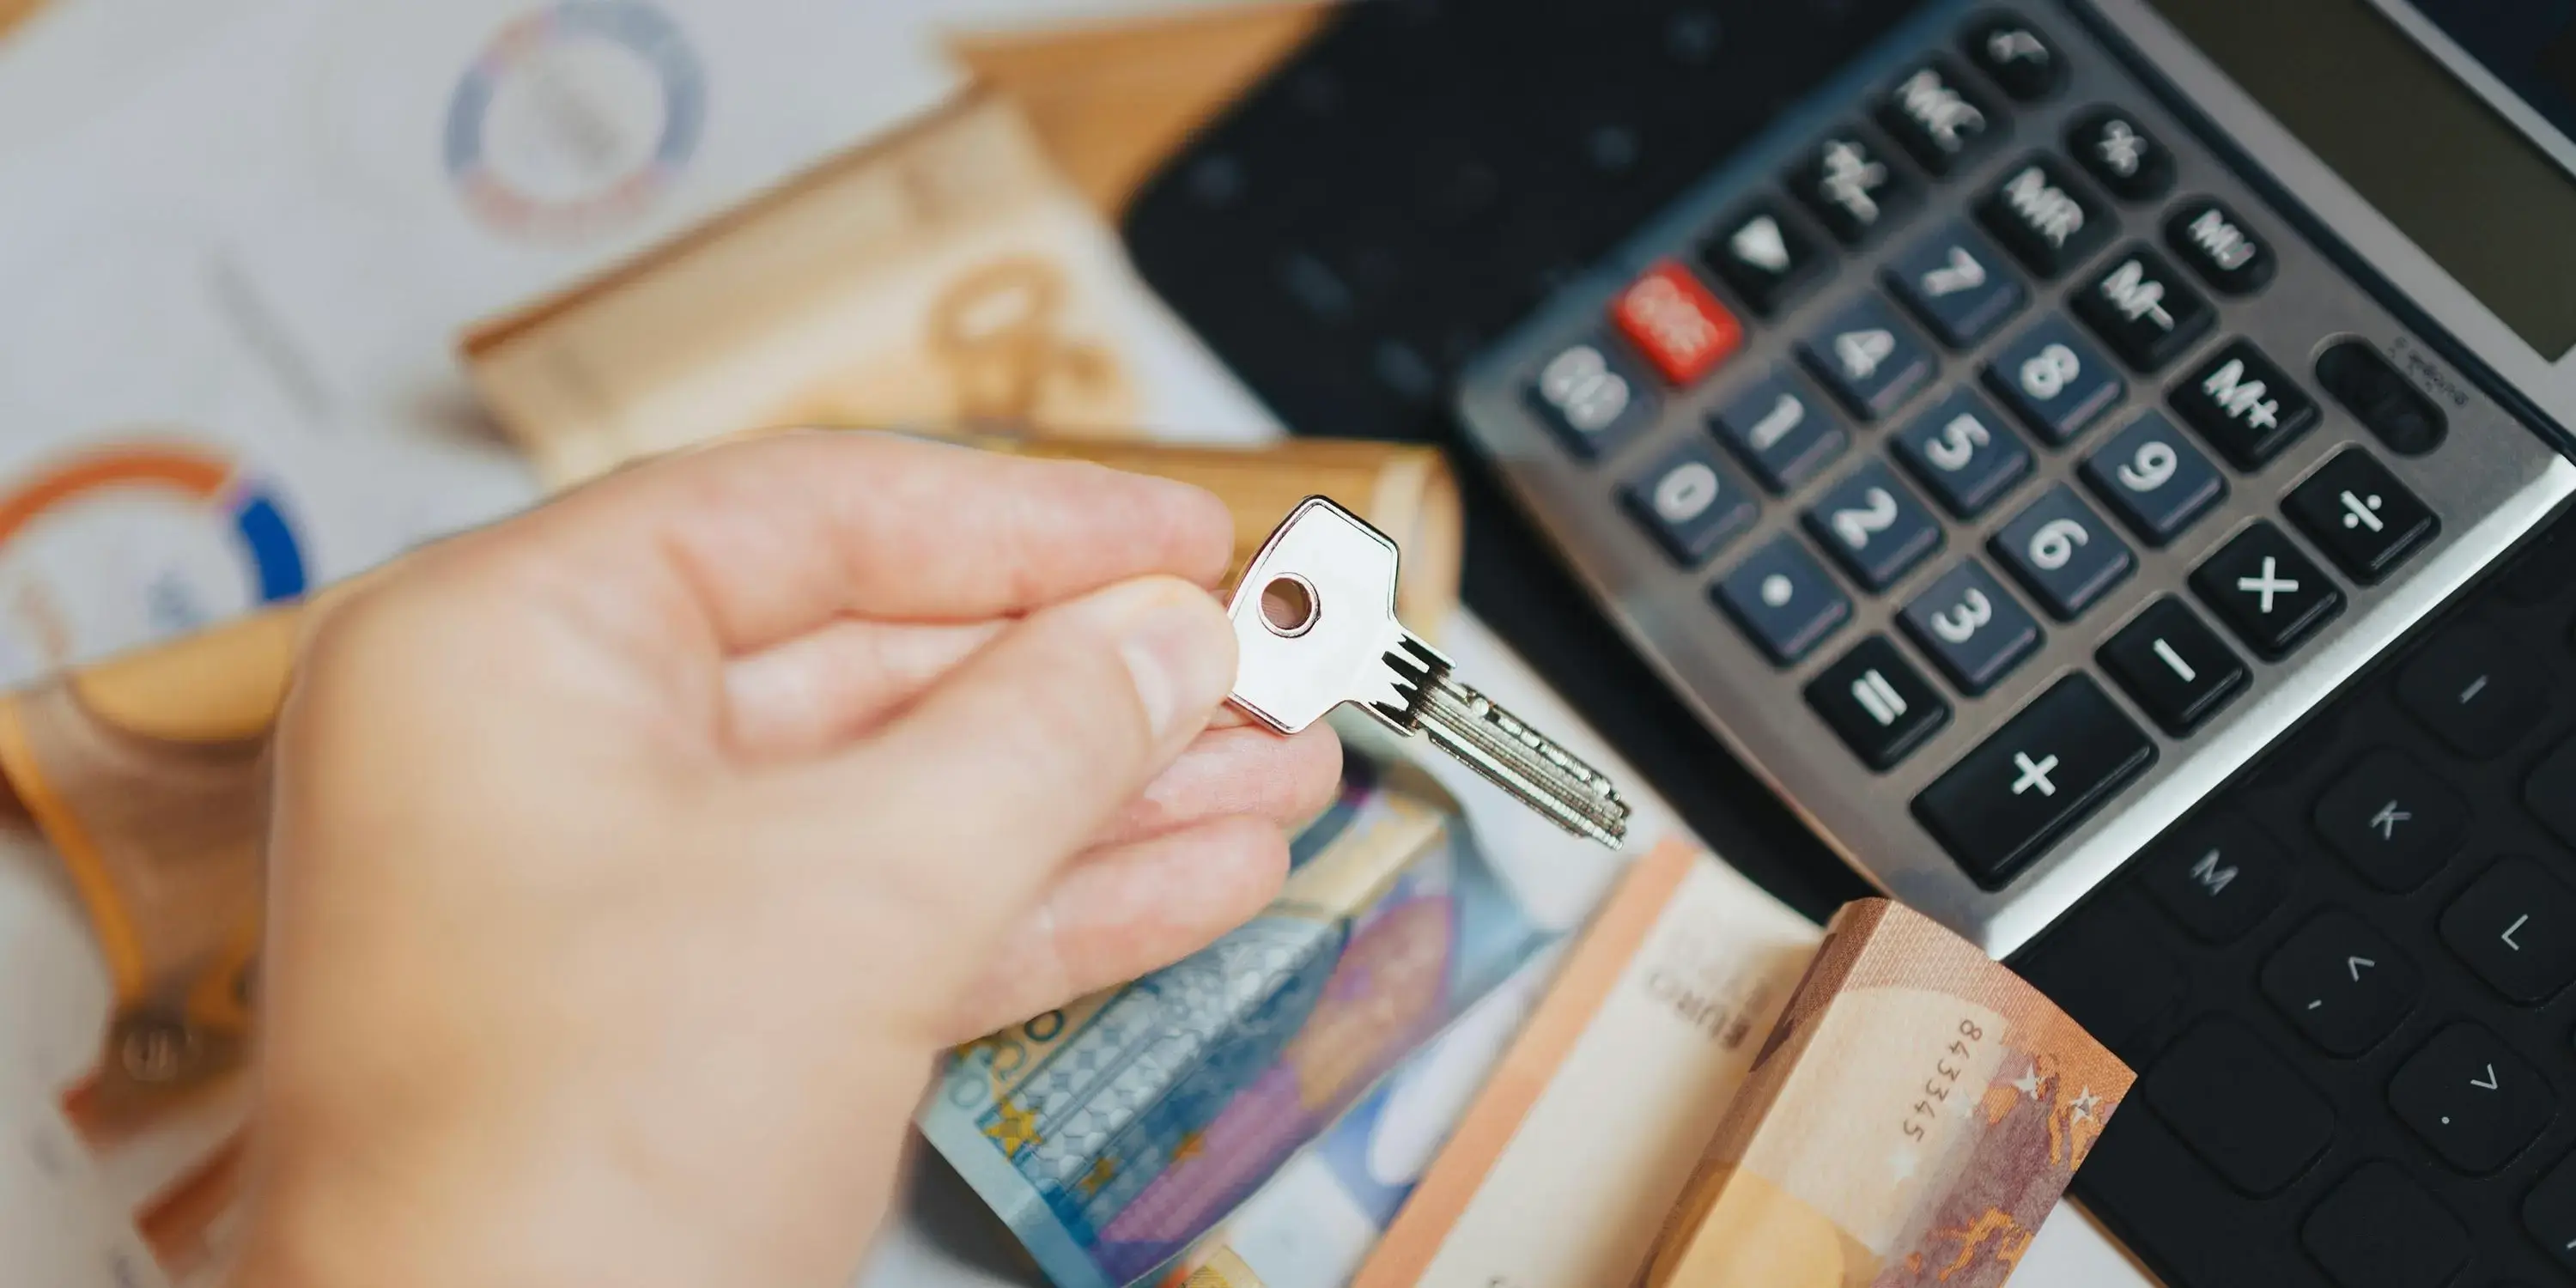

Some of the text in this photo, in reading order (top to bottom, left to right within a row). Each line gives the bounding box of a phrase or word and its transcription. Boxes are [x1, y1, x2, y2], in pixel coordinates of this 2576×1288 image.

[2004, 167, 2084, 248] MR
[2189, 210, 2254, 270] MU
[1923, 246, 1985, 296] 7
[1837, 329, 1895, 379] 4
[2020, 343, 2081, 399] 8
[2202, 357, 2279, 429] M+
[1750, 394, 1804, 449] 1
[1927, 413, 1990, 471] 5
[1655, 462, 1719, 521] 0
[2118, 440, 2178, 492] 9
[1833, 487, 1899, 548] 2
[2028, 518, 2089, 570] 6
[1931, 587, 1993, 643] 3
[2011, 750, 2060, 797] +
[2371, 800, 2411, 840] K
[2191, 849, 2239, 896] M
[2500, 913, 2530, 951] L
[1904, 1019, 1982, 1141] 843345
